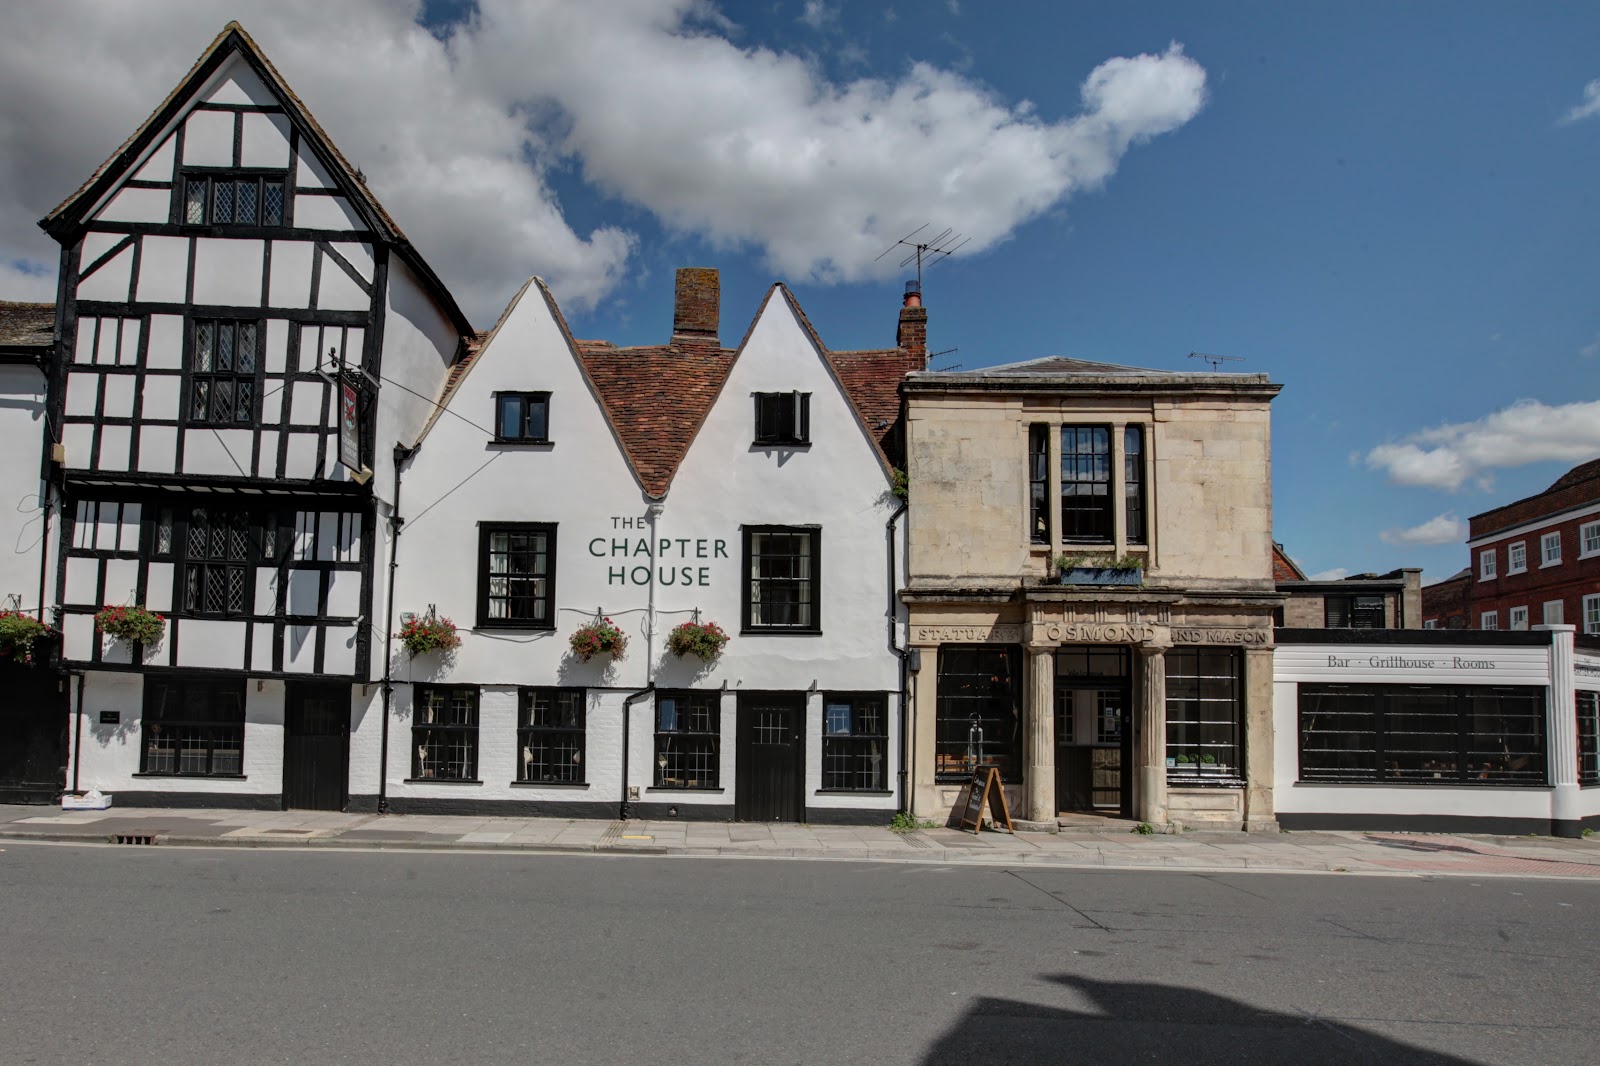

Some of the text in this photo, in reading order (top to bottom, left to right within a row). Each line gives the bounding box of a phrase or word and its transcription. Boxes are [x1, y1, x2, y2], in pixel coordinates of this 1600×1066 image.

[611, 516, 646, 529] THE
[588, 538, 729, 558] CHAPTER
[608, 566, 710, 586] HOUSE
[918, 627, 1017, 641] STATUARY
[1047, 625, 1157, 641] OSMOND
[1206, 629, 1268, 644] MASON
[1327, 655, 1496, 670] Bar Grillhouse Rooms
